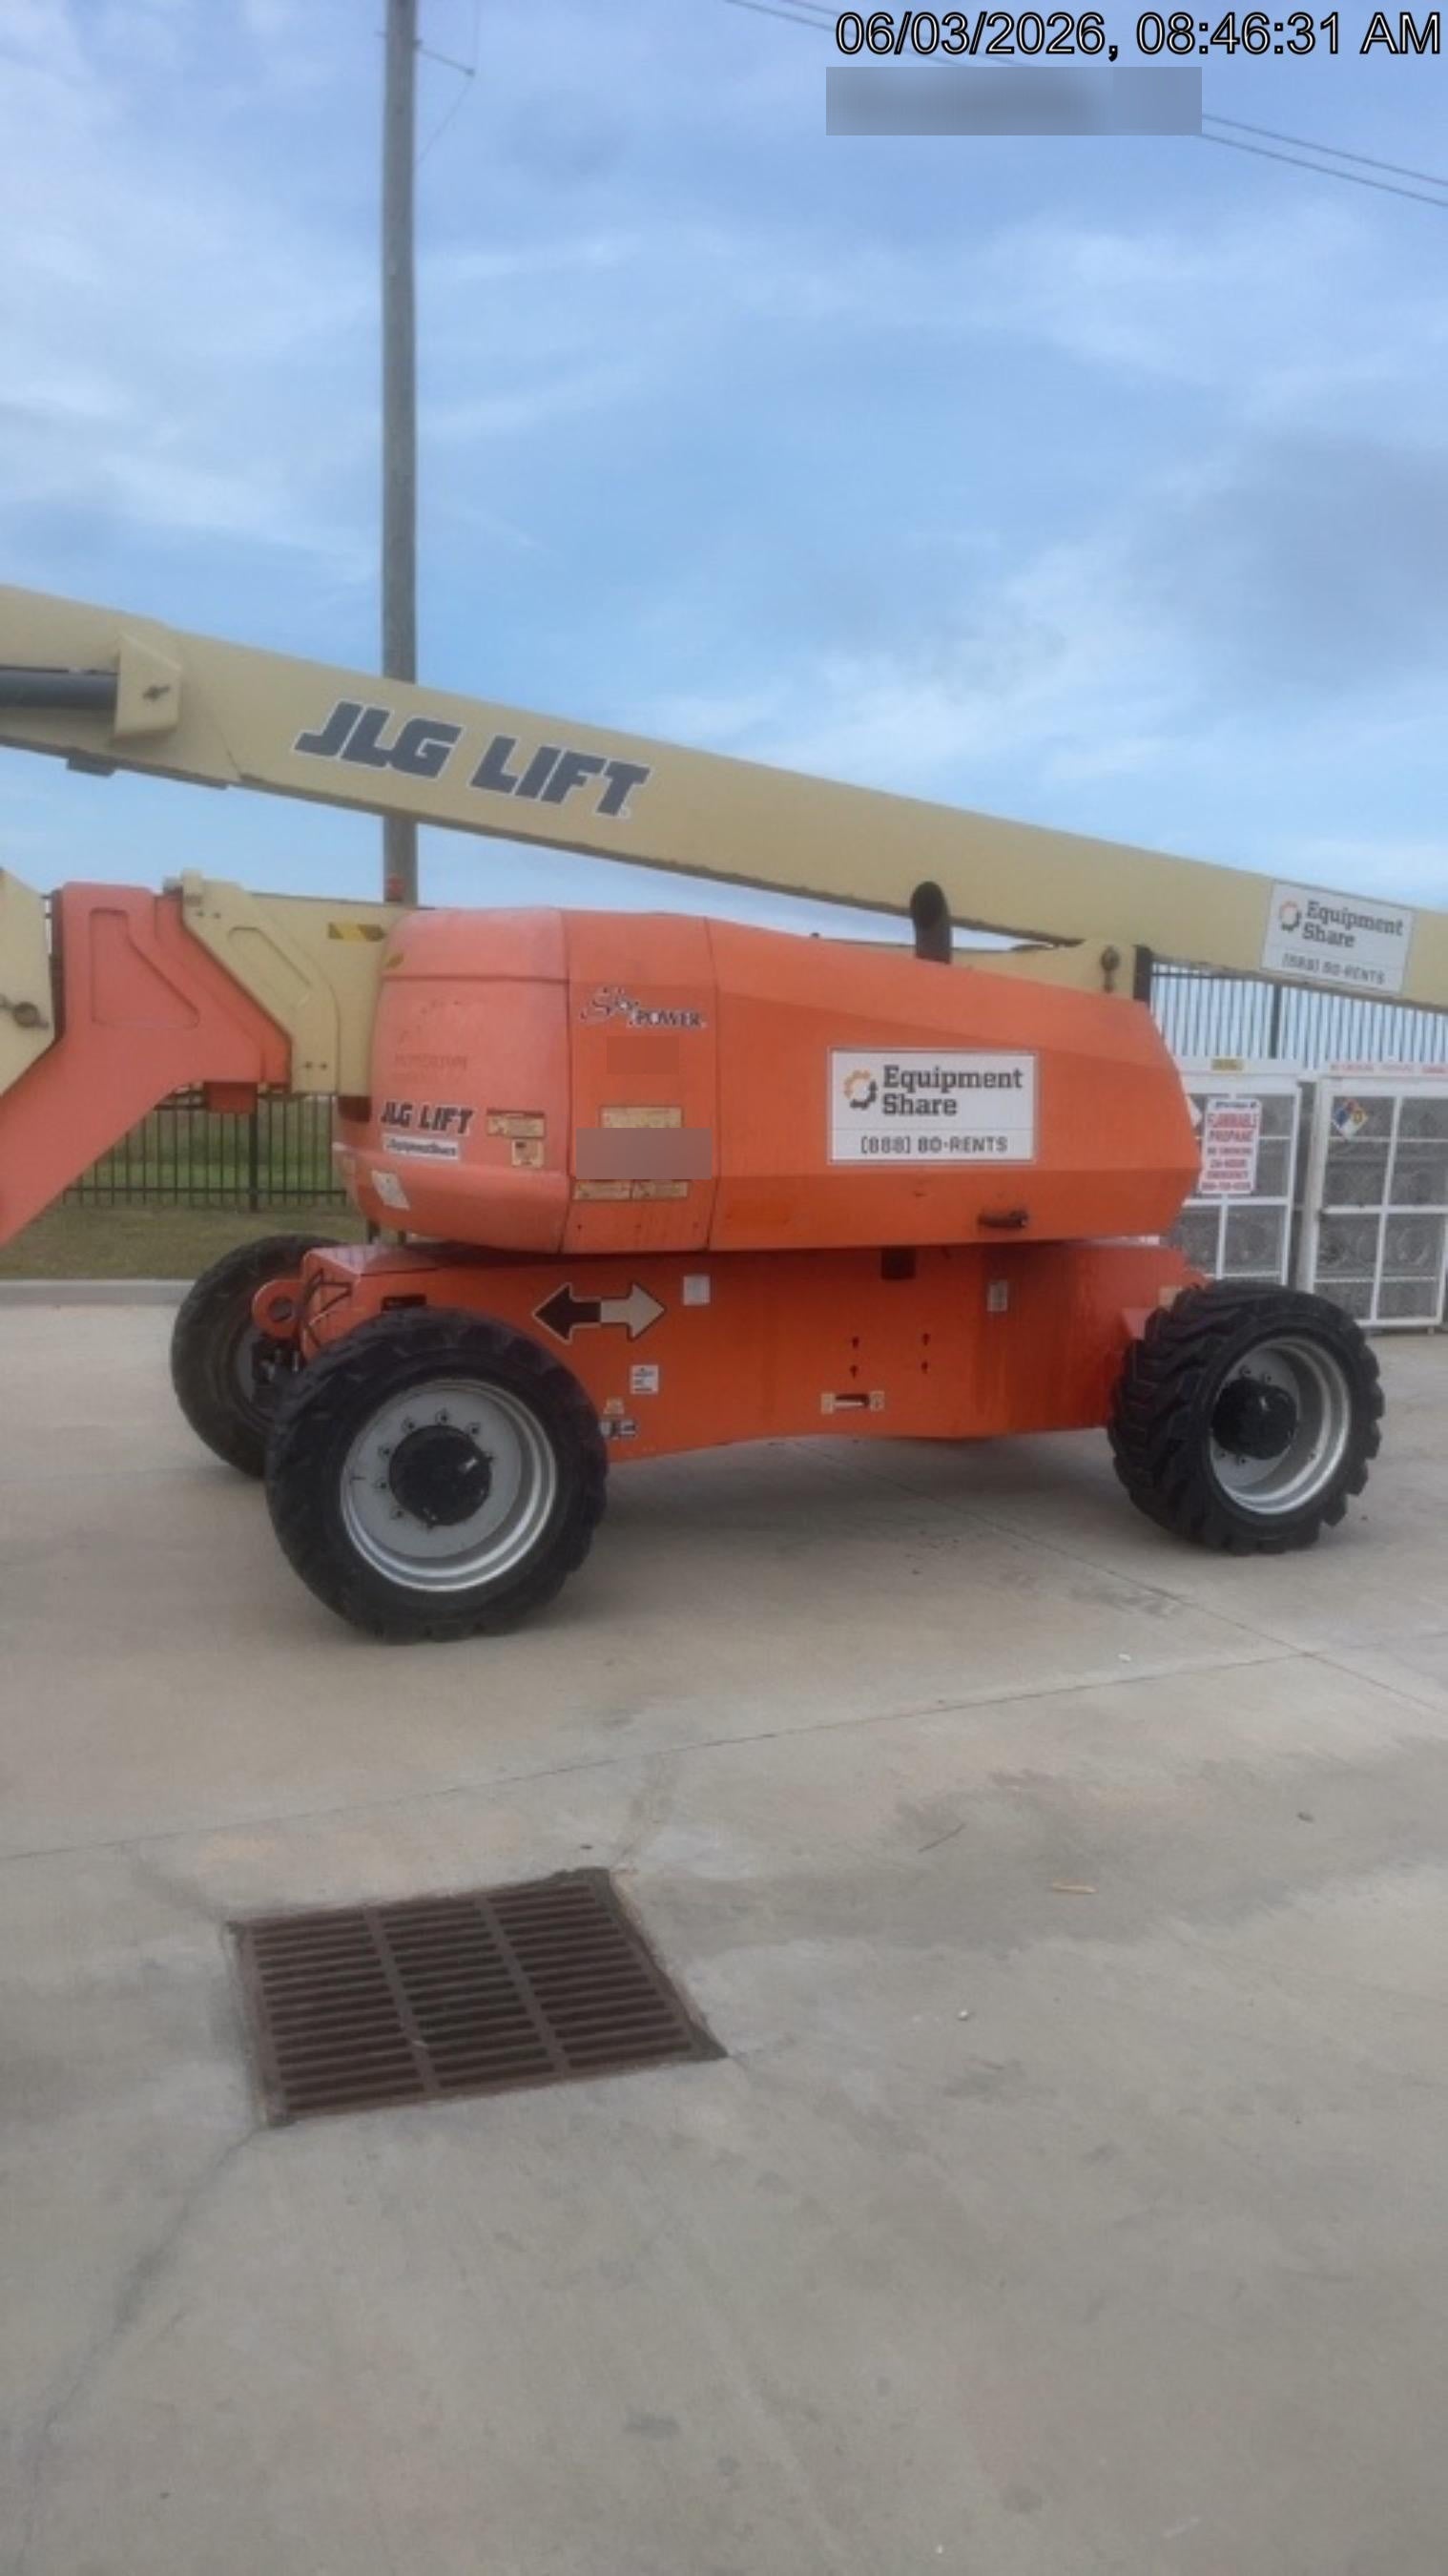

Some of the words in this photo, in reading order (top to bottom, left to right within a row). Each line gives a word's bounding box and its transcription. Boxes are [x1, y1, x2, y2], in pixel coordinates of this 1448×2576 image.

[292, 699, 465, 779] JLG
[469, 734, 652, 817] LIFT
[1306, 900, 1403, 937] Equipment
[1302, 921, 1355, 947] Share
[636, 1008, 704, 1028] POWER
[883, 1065, 1023, 1094] Equipment
[381, 1101, 413, 1128] JLG
[419, 1104, 473, 1133] LIFT
[882, 1093, 957, 1116] Share
